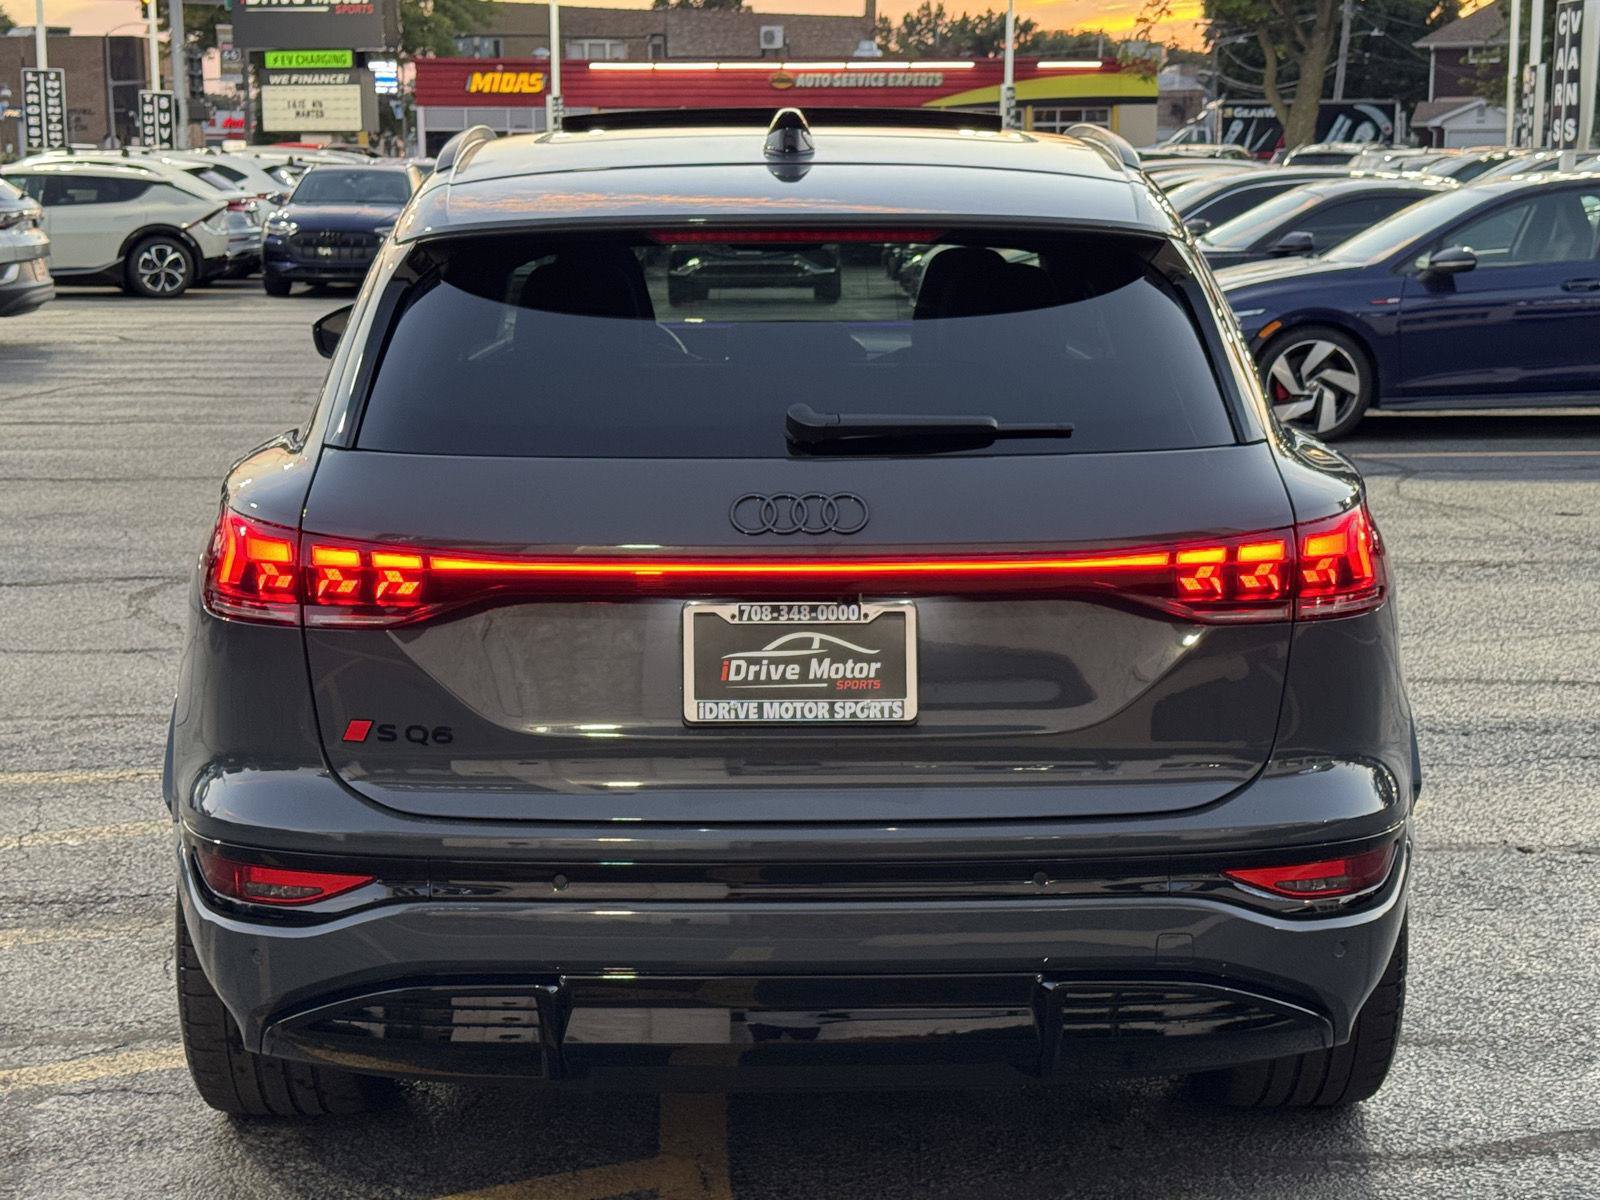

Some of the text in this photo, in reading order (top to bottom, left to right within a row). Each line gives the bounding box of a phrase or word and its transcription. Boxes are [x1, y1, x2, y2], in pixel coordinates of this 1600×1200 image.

[269, 73, 350, 85] WE FINANCE!
[468, 71, 545, 93] MIDAS
[795, 73, 831, 87] AUTO
[832, 72, 886, 87] SERVICE
[887, 72, 944, 87] EXPERTS
[1551, 11, 1567, 143] CARS
[1563, 10, 1582, 143] VANS
[740, 605, 860, 621] 708-348-0000
[720, 658, 882, 682] iDrive Motor
[835, 679, 881, 690] SPORTS
[763, 702, 830, 718] MOTOR
[833, 701, 904, 718] SPORTS
